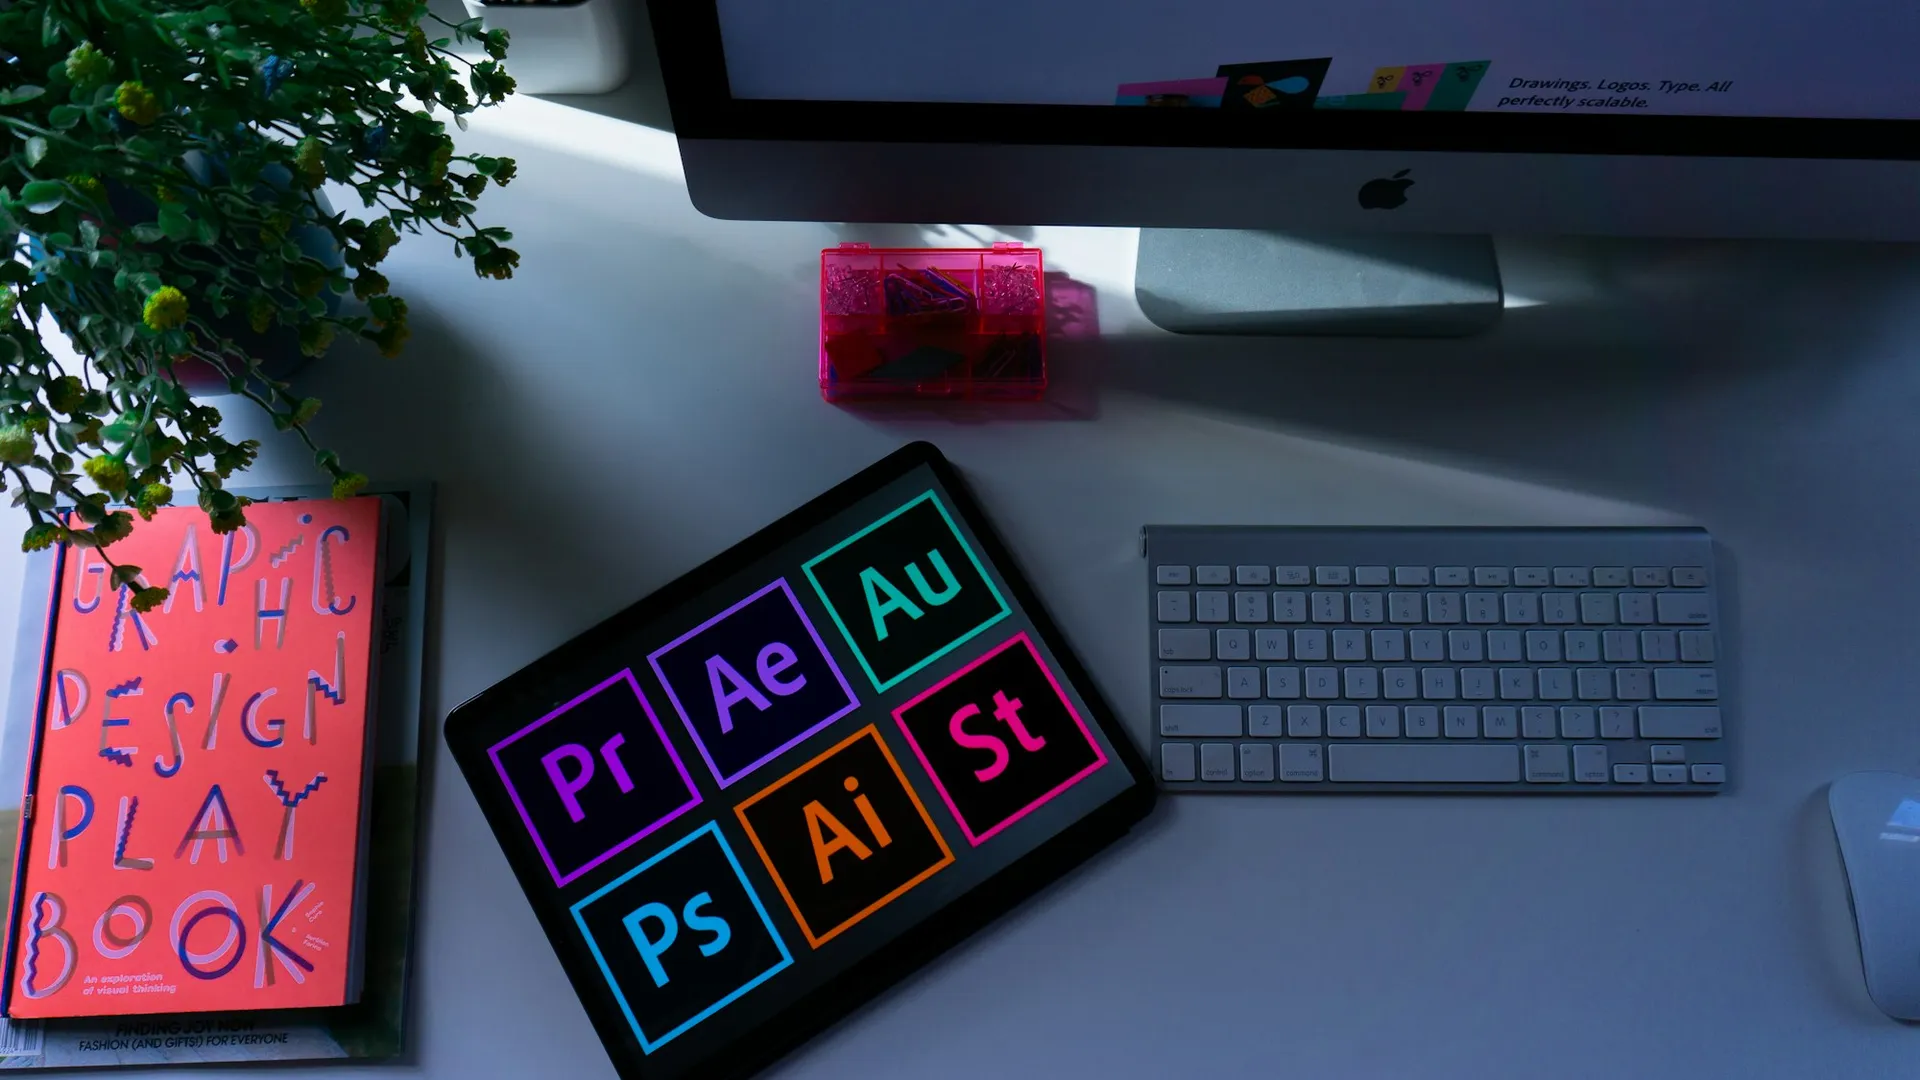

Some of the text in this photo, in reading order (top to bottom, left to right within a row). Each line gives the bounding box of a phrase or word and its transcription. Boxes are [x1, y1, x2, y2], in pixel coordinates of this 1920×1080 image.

[1497, 95, 1649, 109] perfectly scalable.
[1508, 77, 1734, 94] Drawings. Logos. Type. All
[859, 548, 962, 641] Au
[704, 641, 808, 735] Ae
[540, 732, 635, 823] Pr
[947, 689, 1047, 783] St
[48, 769, 328, 870] PLAY
[802, 776, 893, 885] Ai
[21, 879, 316, 998] BOOK
[83, 972, 163, 984] An exploration
[622, 890, 732, 989] Ps
[83, 983, 177, 995] of visual thinking
[116, 1018, 256, 1037] FINDING JOY NOW
[79, 1032, 289, 1052] FASHION (AND GIFTS!) FOR EVERYONE
